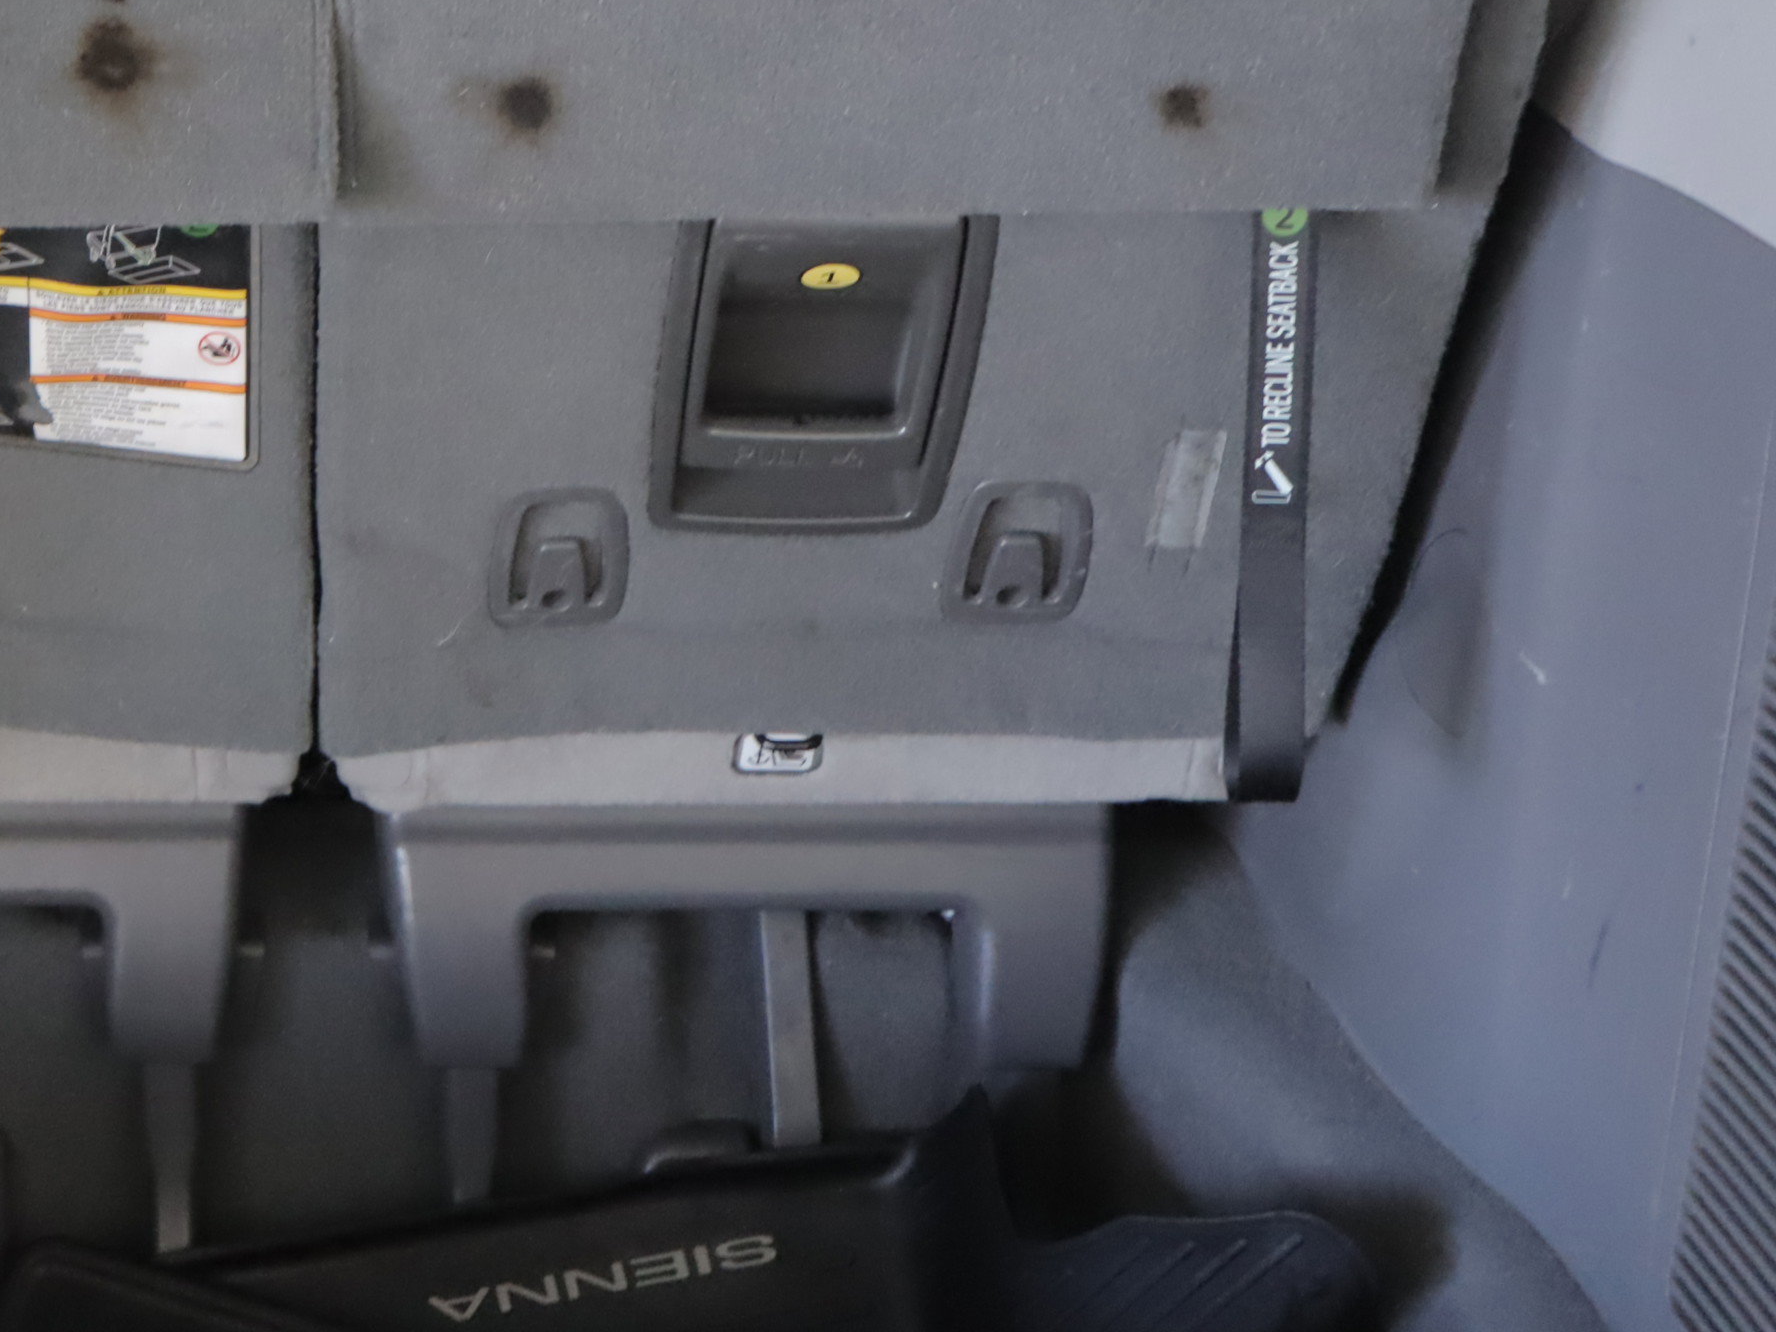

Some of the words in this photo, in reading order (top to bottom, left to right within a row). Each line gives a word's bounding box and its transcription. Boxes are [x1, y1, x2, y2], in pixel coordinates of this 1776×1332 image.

[108, 284, 167, 296] ATTENTION
[1265, 240, 1300, 340] SEATBACK
[1262, 341, 1295, 420] RECLINE
[1261, 421, 1292, 448] TO
[428, 1233, 777, 1323] SIENNA
